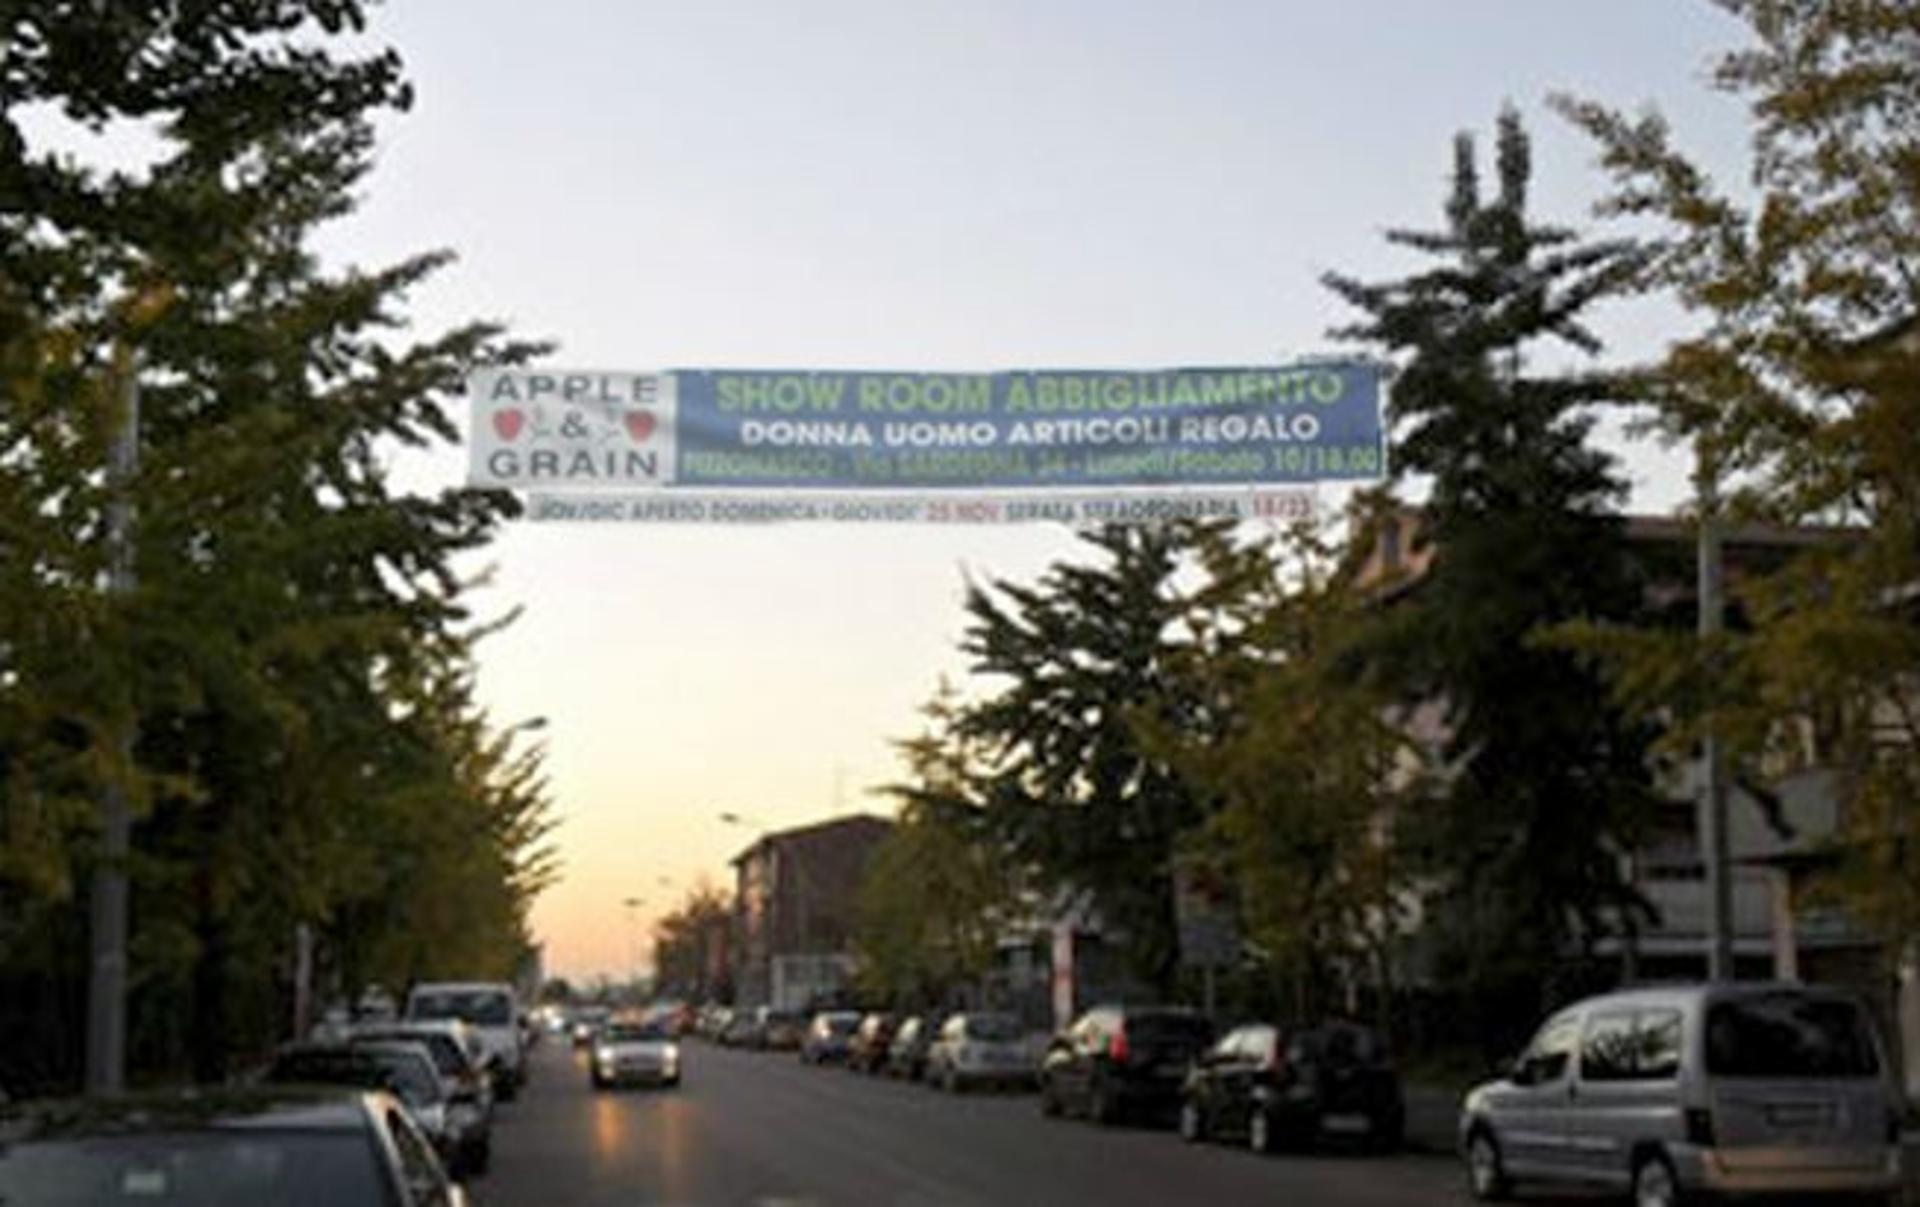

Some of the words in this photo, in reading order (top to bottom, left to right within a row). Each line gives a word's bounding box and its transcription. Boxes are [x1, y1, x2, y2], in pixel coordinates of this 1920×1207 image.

[490, 374, 658, 401] APPLE
[716, 375, 845, 412] SHOW
[858, 376, 992, 413] ROOM
[1003, 371, 1344, 413] ABBIGLIAMENTO
[740, 420, 872, 446] DONNA
[883, 421, 998, 447] UOMO
[1007, 417, 1169, 446] ARTICOLI
[1179, 412, 1320, 443] REGALO
[487, 450, 659, 478] GRAIN
